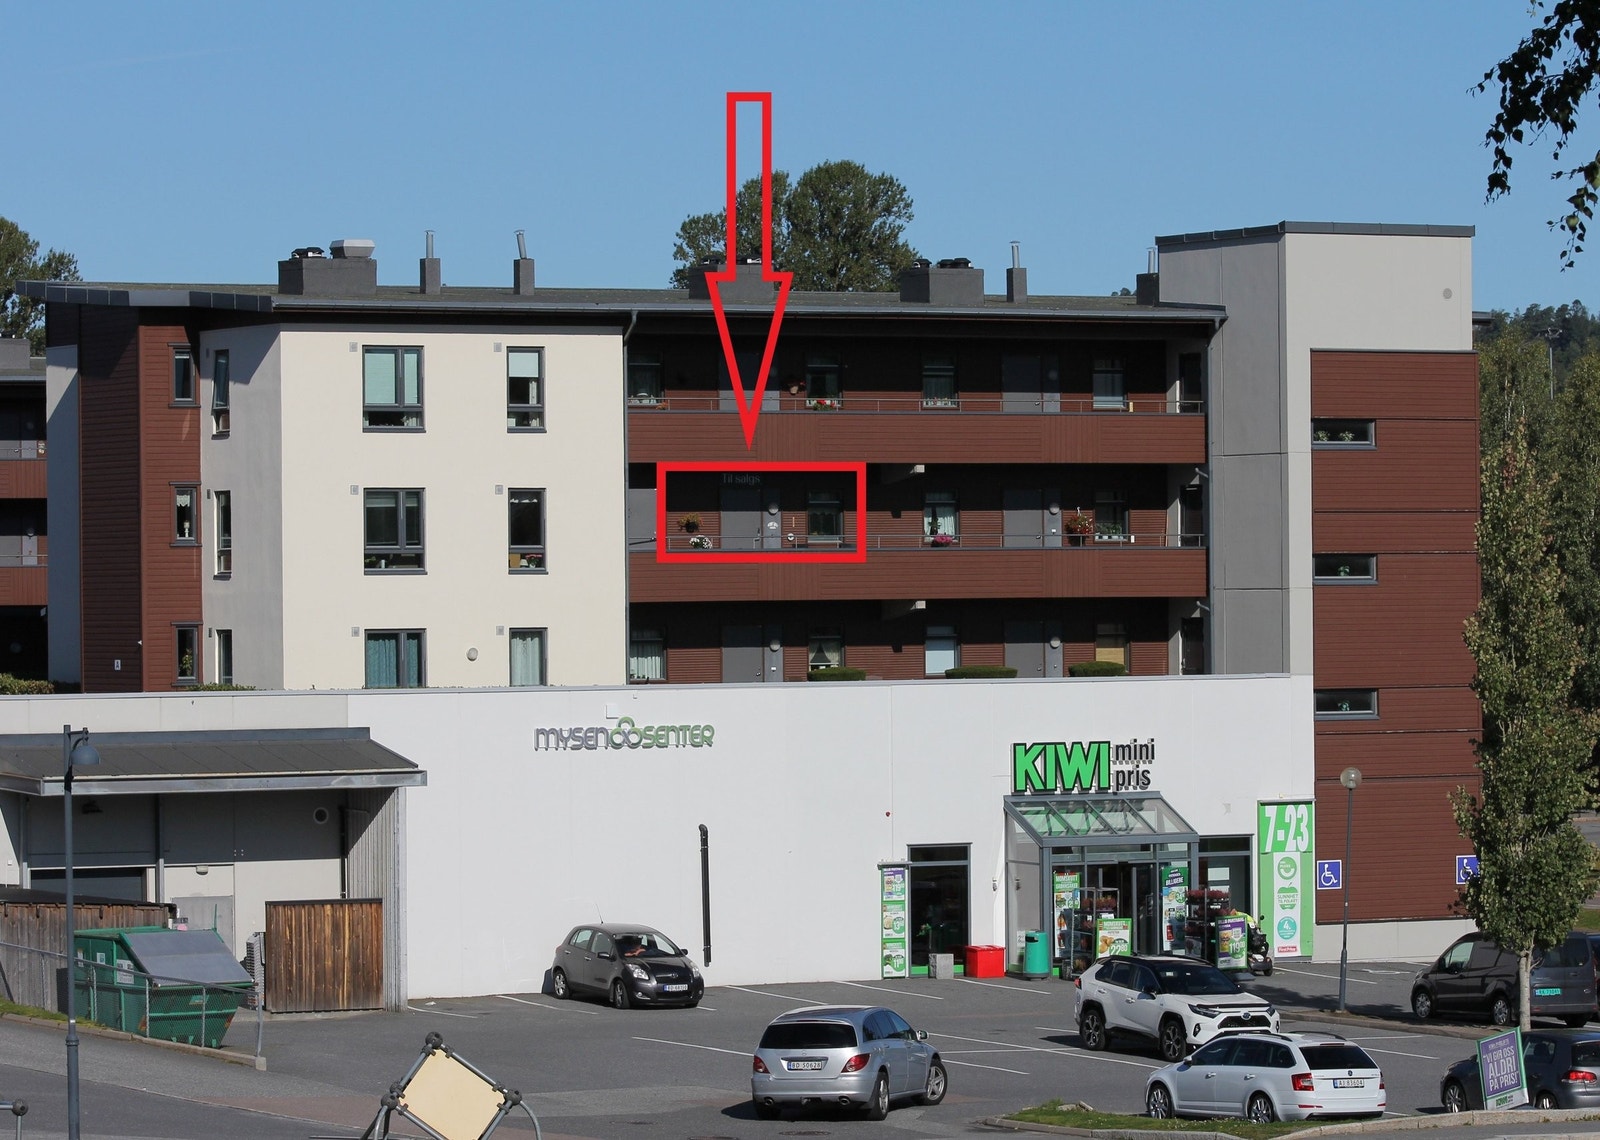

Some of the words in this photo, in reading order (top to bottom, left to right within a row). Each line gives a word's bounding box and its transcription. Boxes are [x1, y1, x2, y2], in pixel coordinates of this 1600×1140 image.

[1115, 738, 1155, 762] mini
[1011, 741, 1111, 794] KIWI
[1114, 764, 1152, 791] pris
[1265, 804, 1309, 852] 7-23
[1503, 1045, 1515, 1058] OSS
[1489, 1056, 1517, 1080] ALDRI
